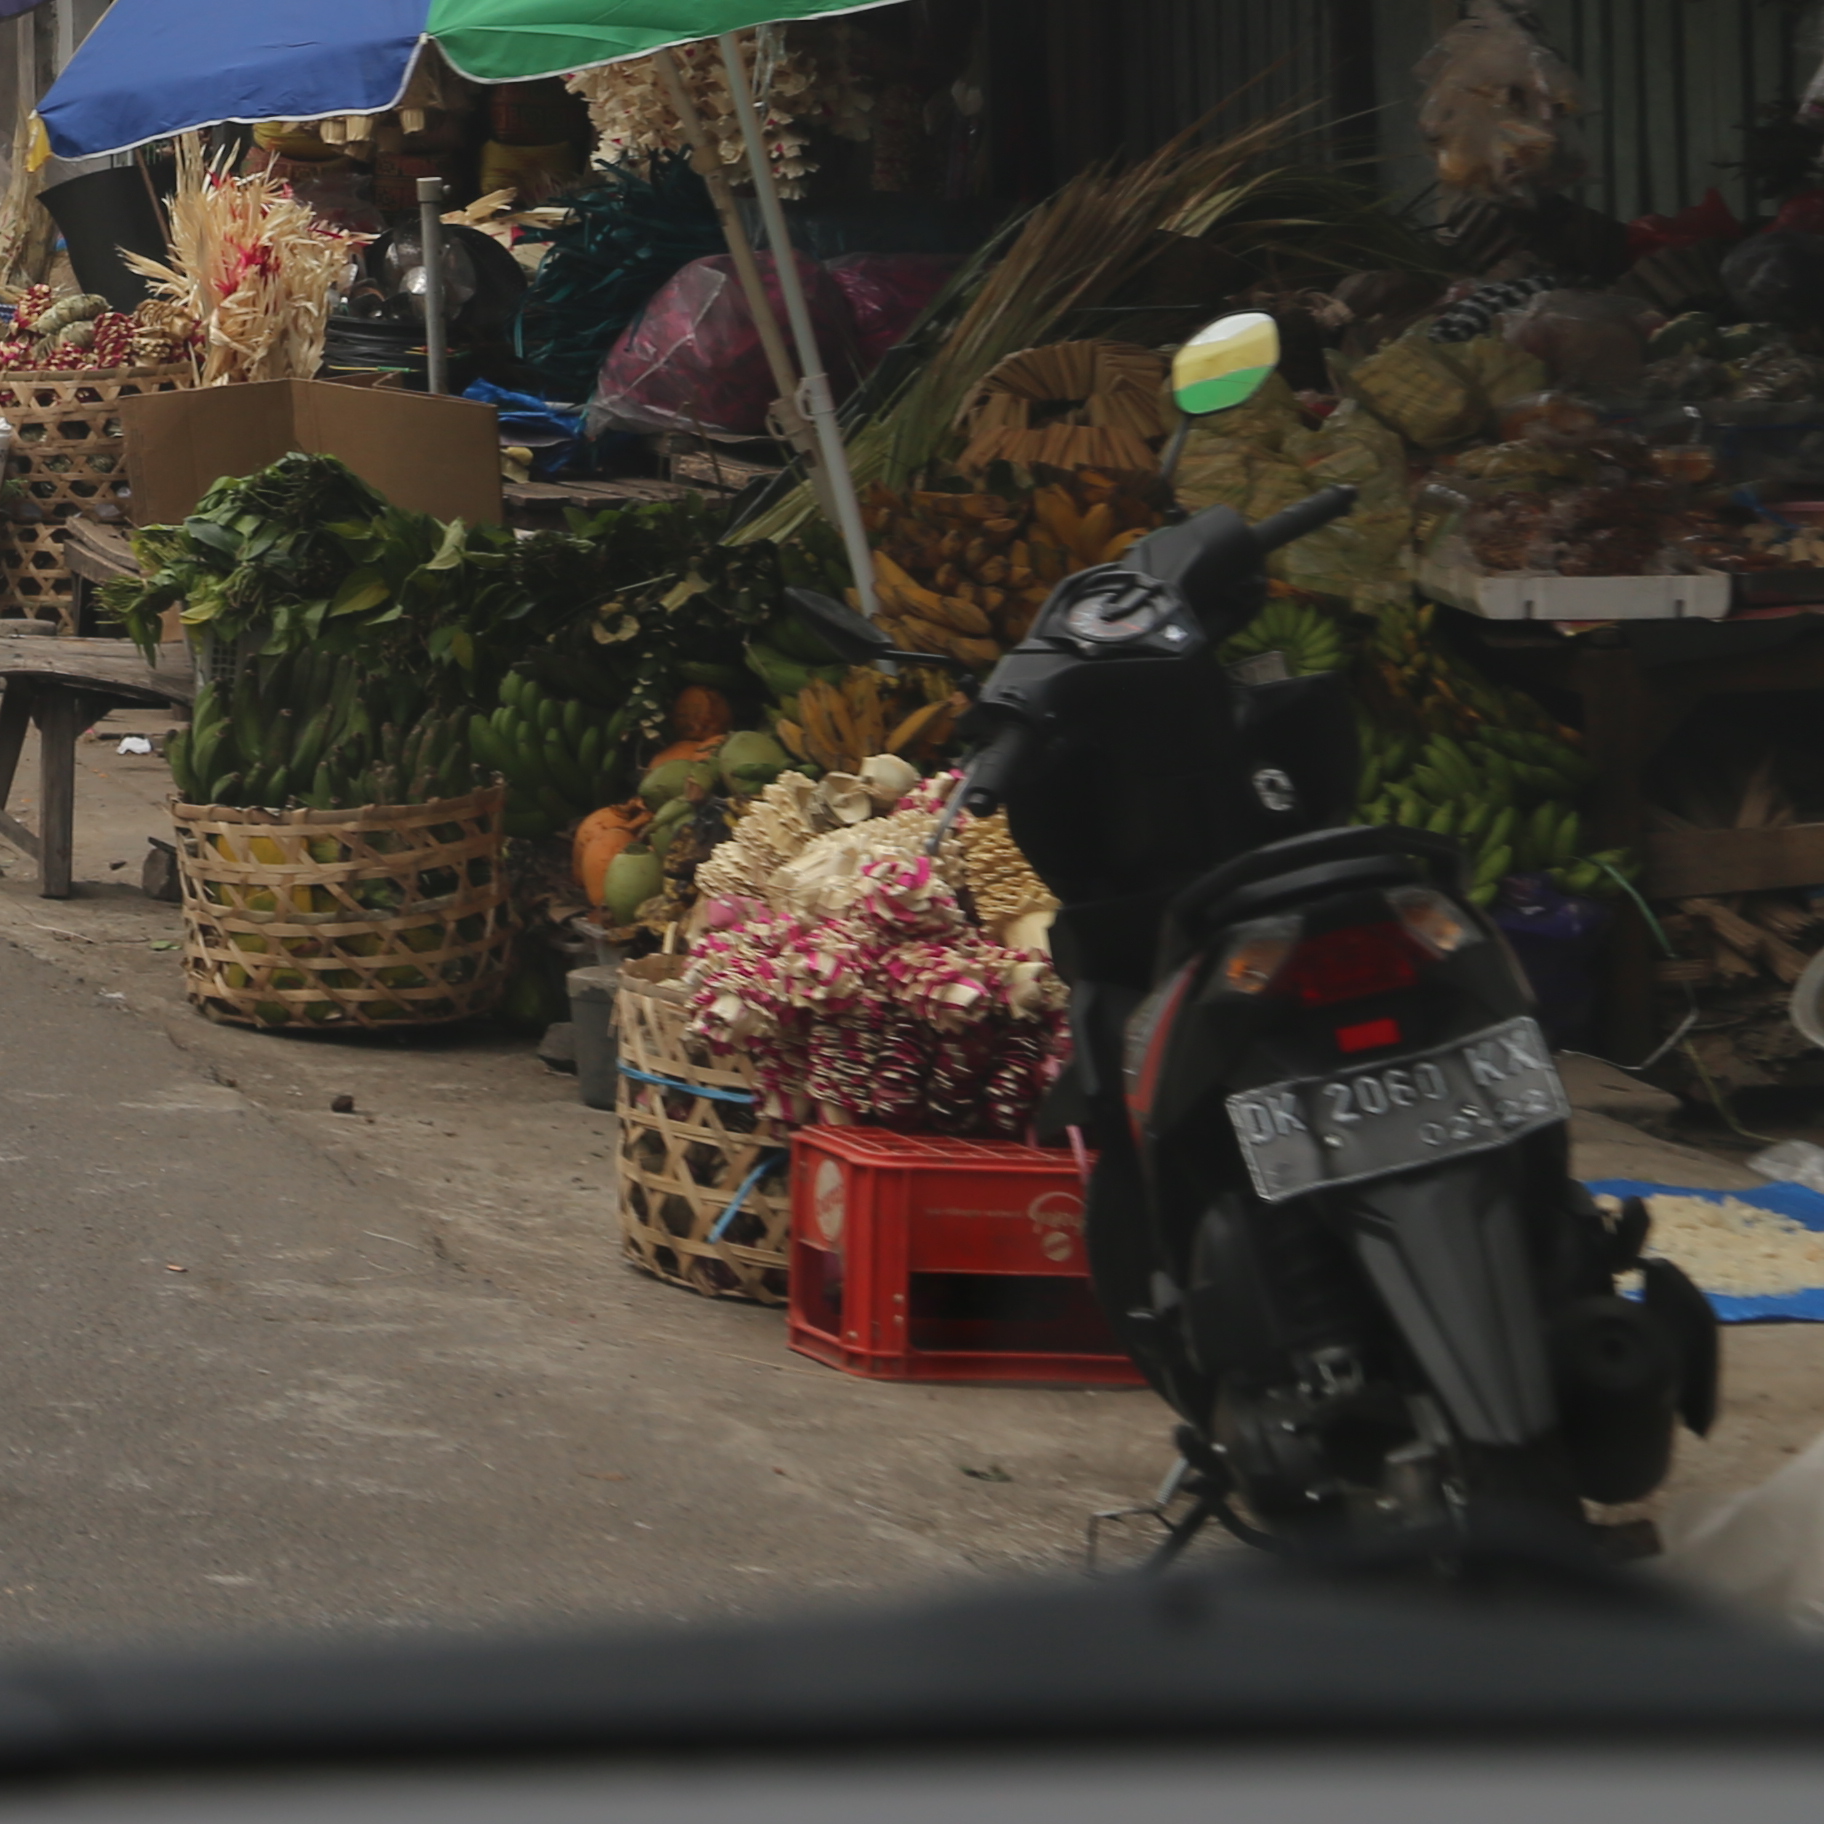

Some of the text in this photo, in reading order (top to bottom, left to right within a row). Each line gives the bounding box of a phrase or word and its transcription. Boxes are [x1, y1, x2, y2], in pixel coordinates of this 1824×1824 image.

[1240, 1028, 1540, 1145] DK 2060 KX
